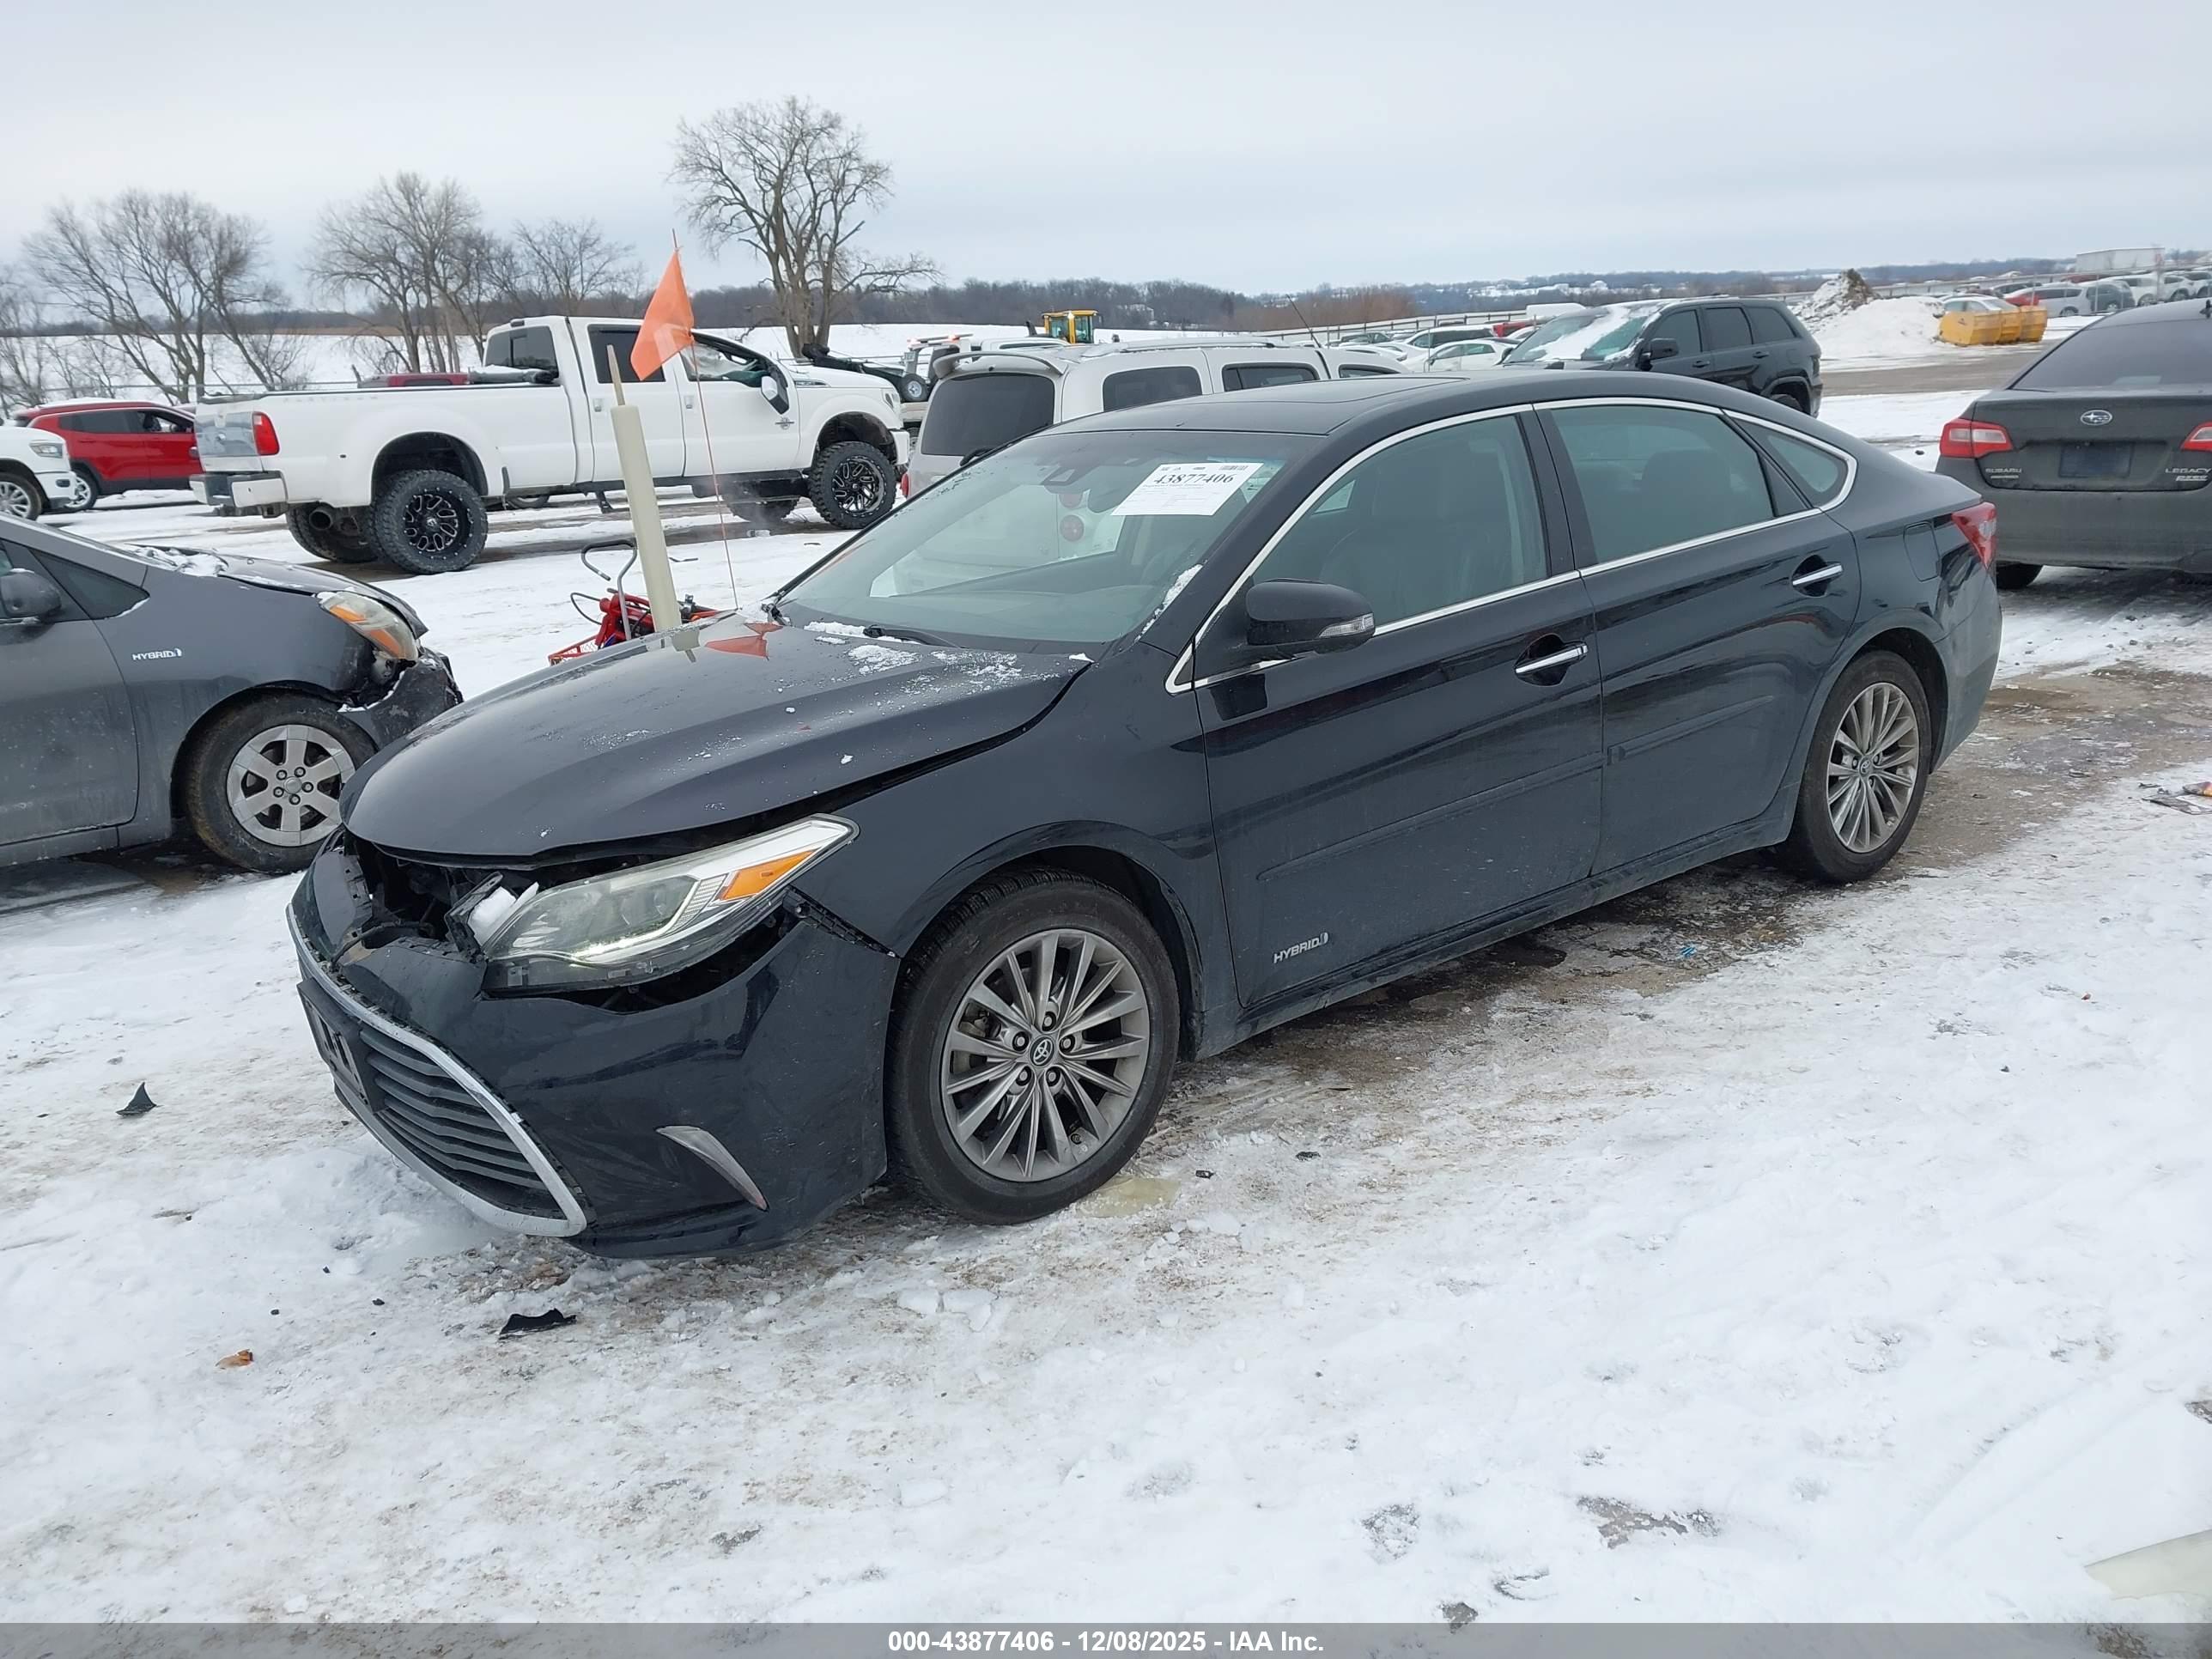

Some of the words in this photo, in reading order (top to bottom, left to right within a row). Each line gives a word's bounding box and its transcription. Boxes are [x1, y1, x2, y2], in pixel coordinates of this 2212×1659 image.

[1153, 473, 1237, 484] 43877406
[131, 650, 175, 660] HYBRID
[1273, 937, 1321, 964] HYBRID
